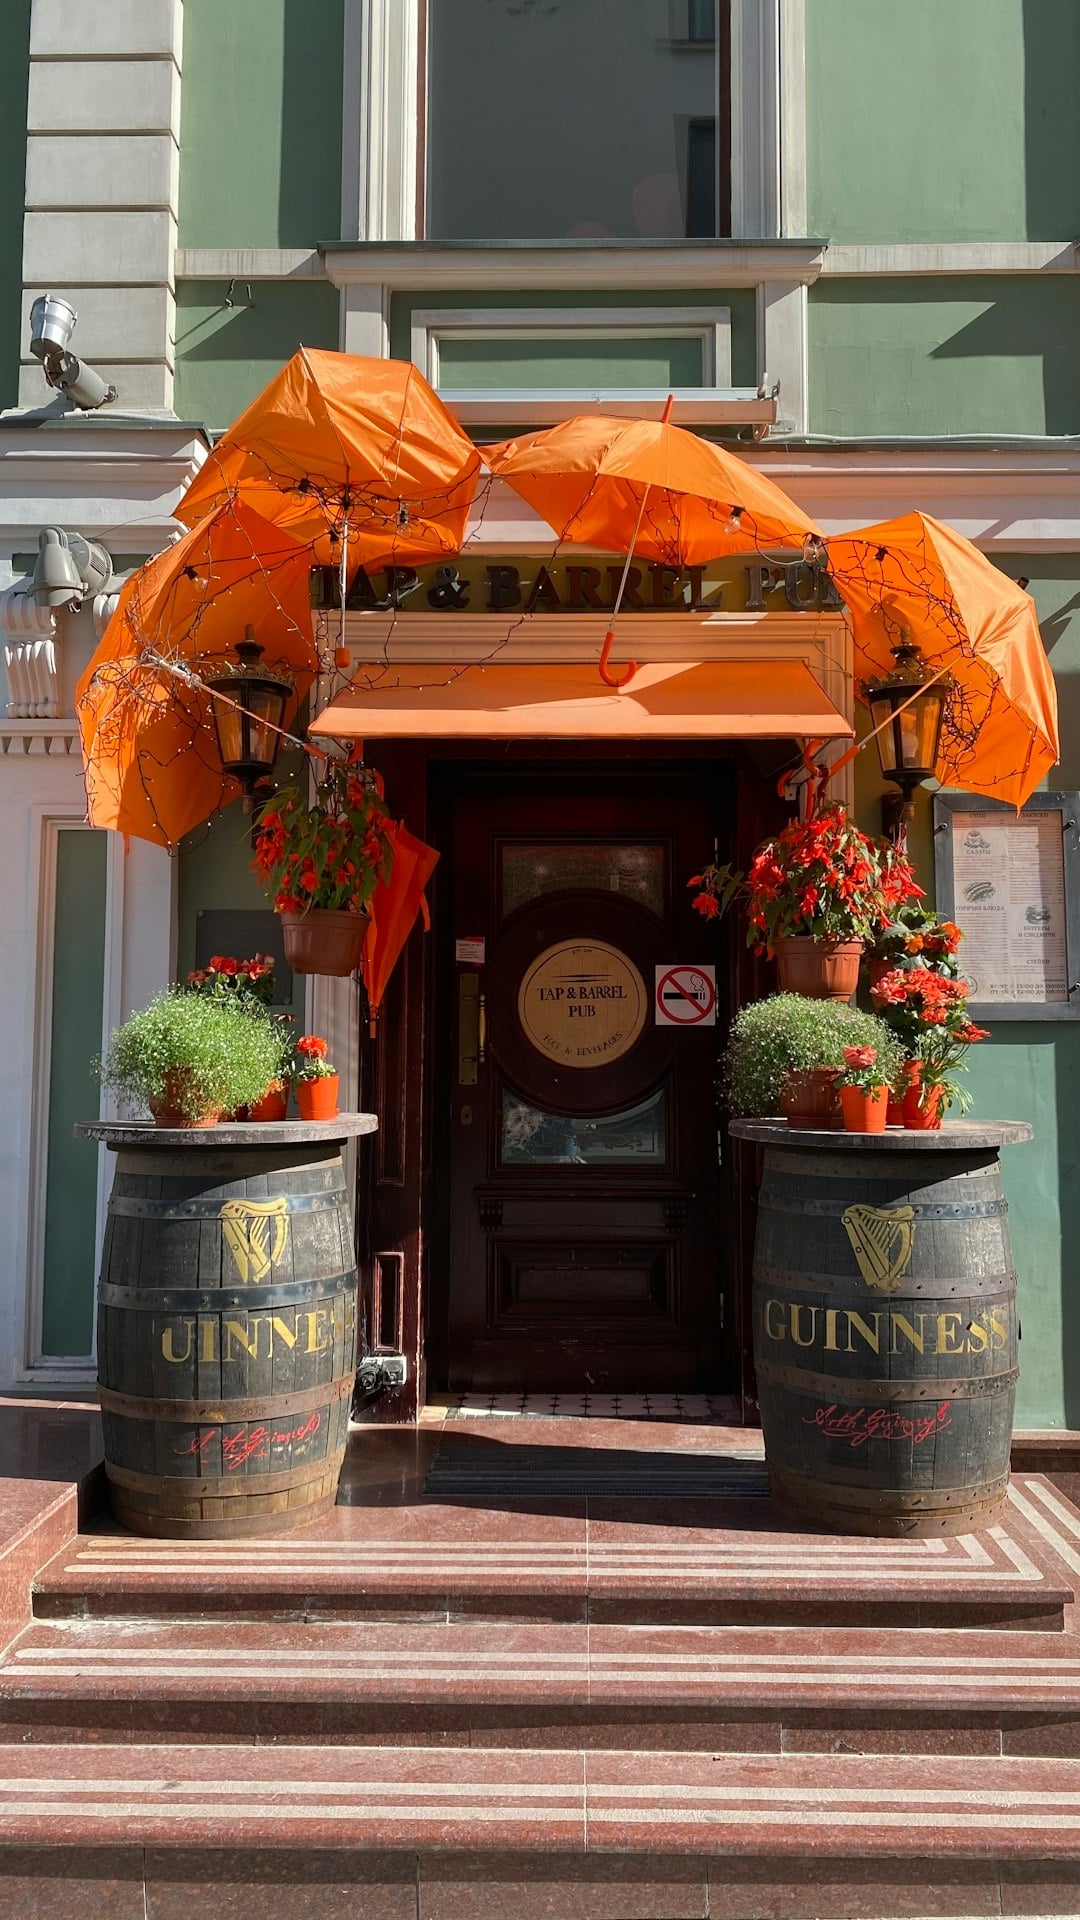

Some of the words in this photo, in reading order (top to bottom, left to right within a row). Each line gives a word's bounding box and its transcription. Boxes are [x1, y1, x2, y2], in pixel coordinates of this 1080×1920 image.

[310, 564, 418, 609] TAP
[427, 565, 471, 609] &
[486, 565, 723, 609] BARREL
[537, 987, 565, 1001] TAP
[566, 987, 577, 1000] &
[578, 986, 628, 1000] BARREL
[567, 1005, 597, 1018] PUB
[764, 1299, 1008, 1356] GUINNESS
